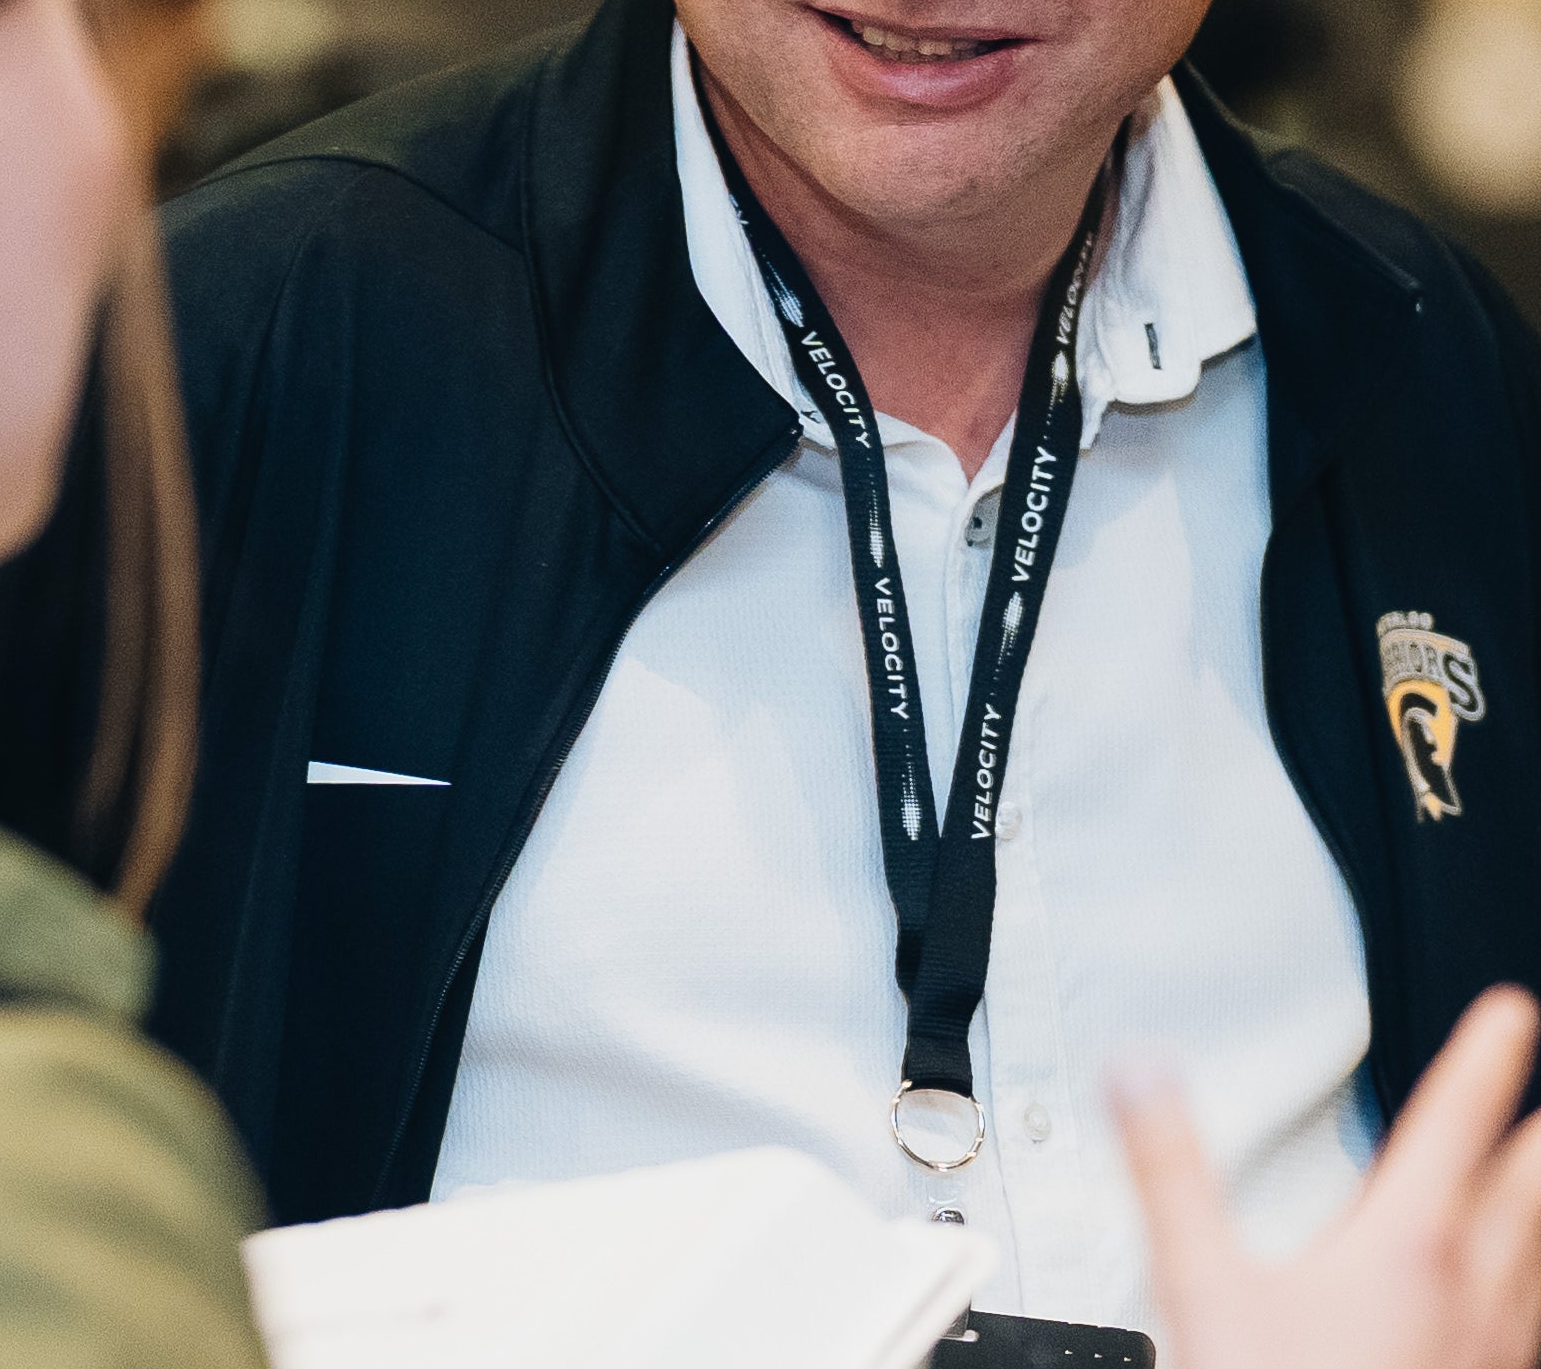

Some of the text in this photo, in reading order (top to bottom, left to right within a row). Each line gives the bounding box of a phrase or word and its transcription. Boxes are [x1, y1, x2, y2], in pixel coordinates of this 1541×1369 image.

[800, 330, 872, 449] VELOCITY
[1011, 446, 1058, 584] VELOCITY
[873, 577, 910, 721] VELOCITY
[970, 704, 1002, 841] VELOCITY
